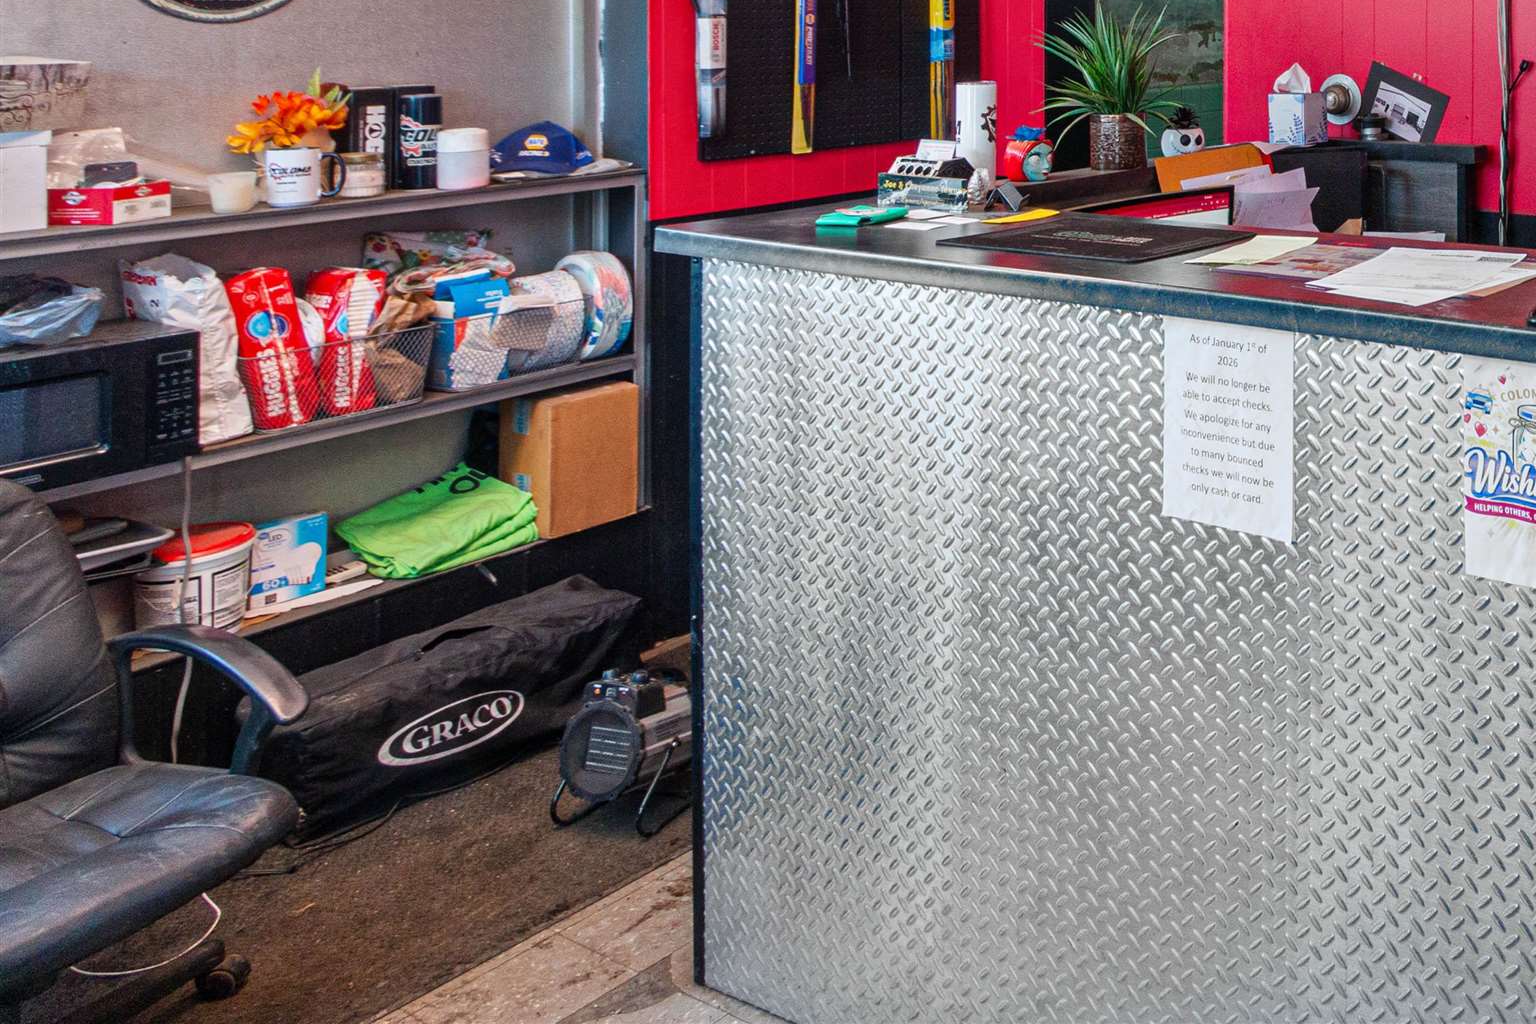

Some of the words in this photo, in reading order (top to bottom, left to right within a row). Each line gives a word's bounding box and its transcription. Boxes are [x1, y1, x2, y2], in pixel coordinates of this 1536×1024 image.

[712, 23, 721, 51] BOSCH
[1190, 334, 1201, 345] As
[1202, 336, 1211, 345] of
[1212, 337, 1244, 352] January
[1247, 342, 1256, 352] 1st
[1258, 344, 1267, 354] of
[1217, 355, 1238, 368] 2026
[256, 348, 287, 417] HUGGIES
[1186, 372, 1199, 382] We
[1200, 373, 1216, 385] will
[1218, 377, 1229, 387] no
[1231, 376, 1256, 393] longer
[1259, 381, 1270, 393] be
[1183, 391, 1200, 401] able
[1202, 393, 1211, 402] to
[1212, 395, 1240, 408] accept
[1242, 400, 1273, 412] checks.
[1185, 409, 1198, 420] We
[1199, 414, 1240, 428] apologize
[1241, 418, 1253, 429] for
[1256, 422, 1271, 435] any
[1181, 428, 1240, 446] inconvenience
[1242, 438, 1256, 449] but
[1258, 440, 1275, 451] due
[1191, 446, 1200, 457] to
[1201, 450, 1225, 462] many
[1227, 453, 1264, 468] bounced
[1182, 463, 1209, 476] checks
[1211, 469, 1223, 478] we
[1226, 469, 1240, 481] will
[1241, 474, 1260, 487] now
[1262, 477, 1274, 489] be
[1191, 482, 1210, 495] only
[1211, 487, 1229, 498] cash
[1231, 490, 1241, 499] or
[1242, 491, 1264, 504] card.
[1474, 503, 1504, 515] HELPING
[1504, 506, 1533, 521] OTHERS,
[402, 696, 511, 754] GRACO
